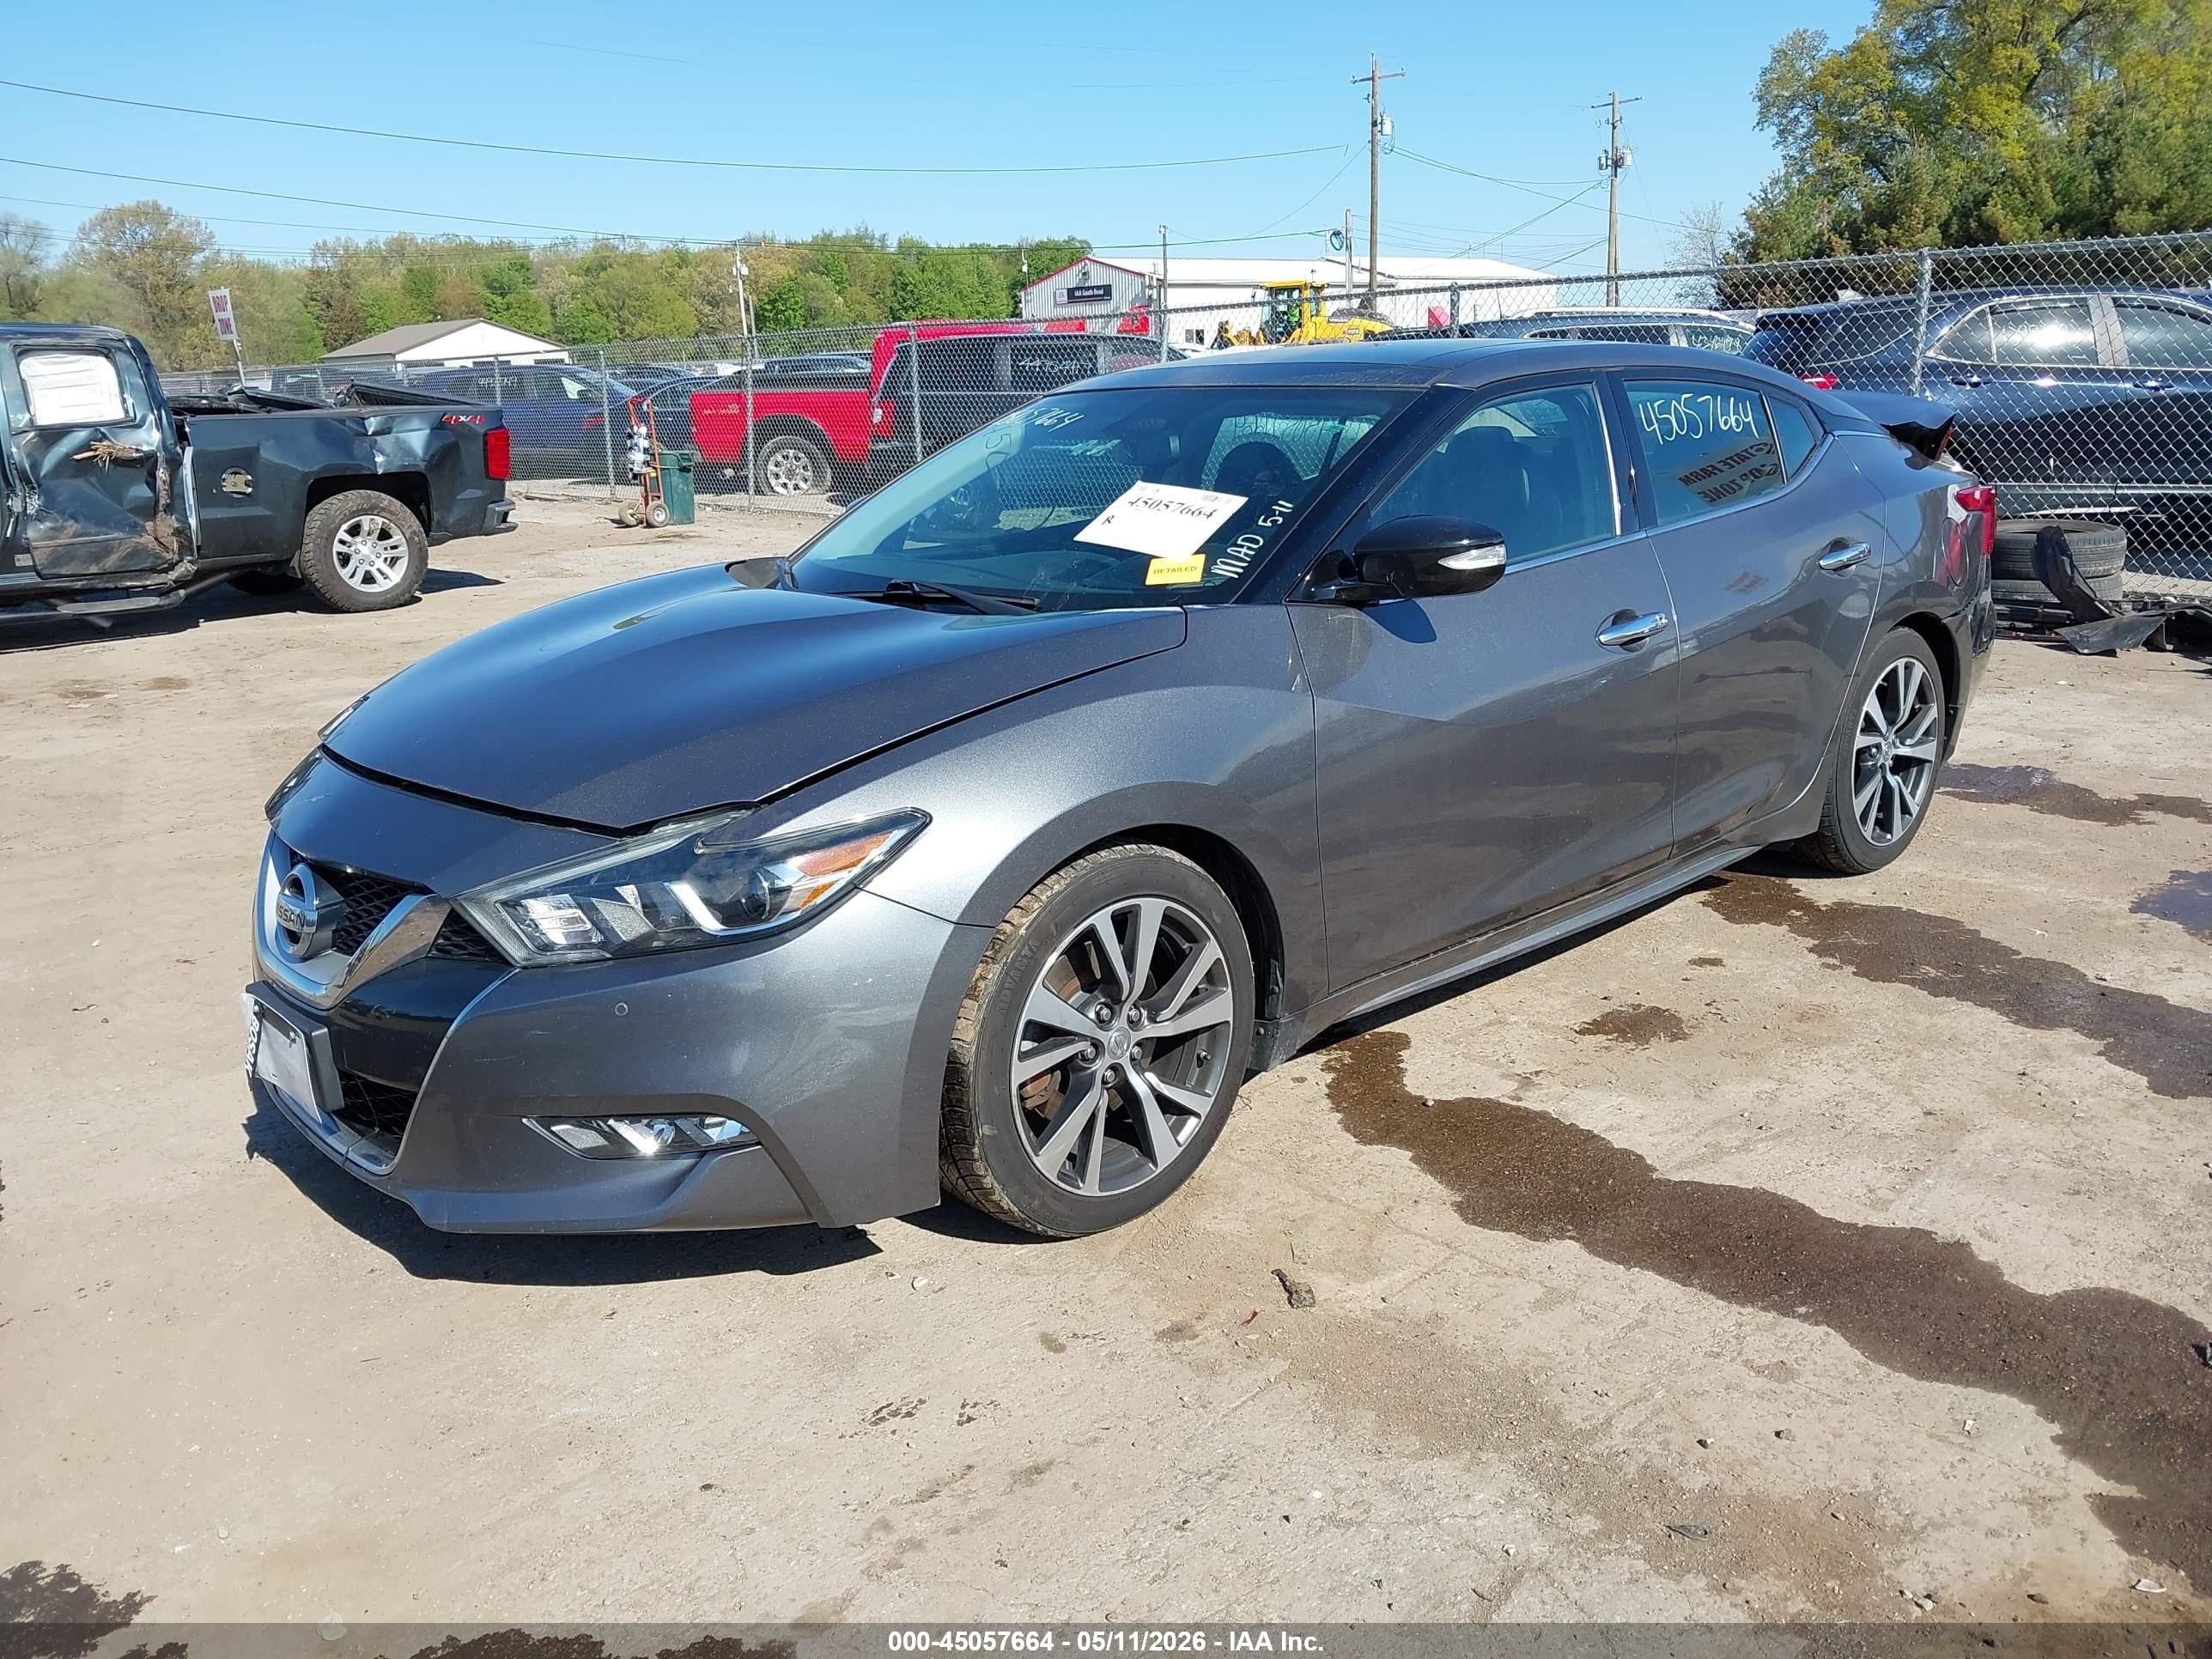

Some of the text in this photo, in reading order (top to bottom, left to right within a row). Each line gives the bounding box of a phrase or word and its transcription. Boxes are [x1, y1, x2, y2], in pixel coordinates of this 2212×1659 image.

[212, 295, 228, 313] DROP
[218, 317, 234, 335] ZONE
[1638, 393, 1759, 446] 45057664
[1128, 497, 1218, 519] 45057664
[1211, 534, 1264, 578] MAD
[1153, 566, 1197, 574] DETAILED
